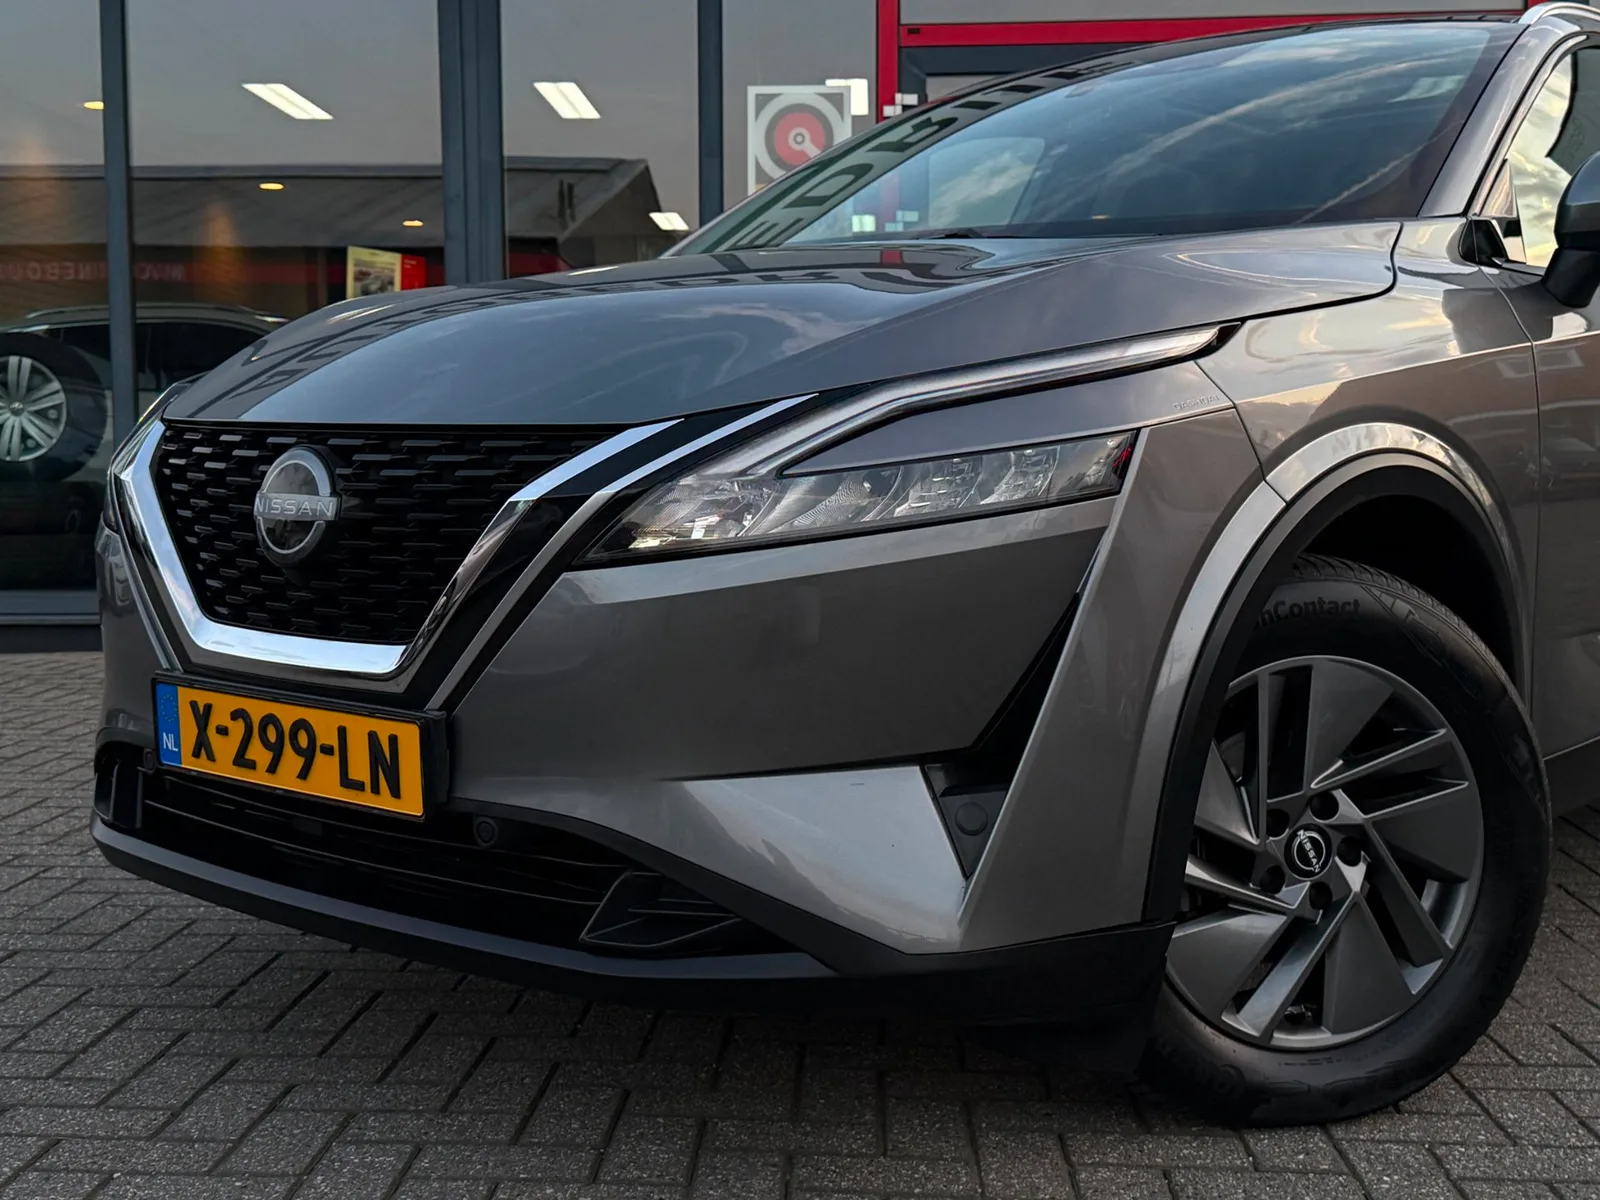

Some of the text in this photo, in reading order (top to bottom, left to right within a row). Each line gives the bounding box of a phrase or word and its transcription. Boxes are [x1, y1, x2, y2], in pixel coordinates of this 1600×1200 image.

[254, 498, 333, 516] NISSAN
[1255, 596, 1361, 630] nContact
[163, 731, 179, 752] NL
[189, 700, 401, 799] X-299-LN
[1297, 829, 1320, 873] NISSAN
